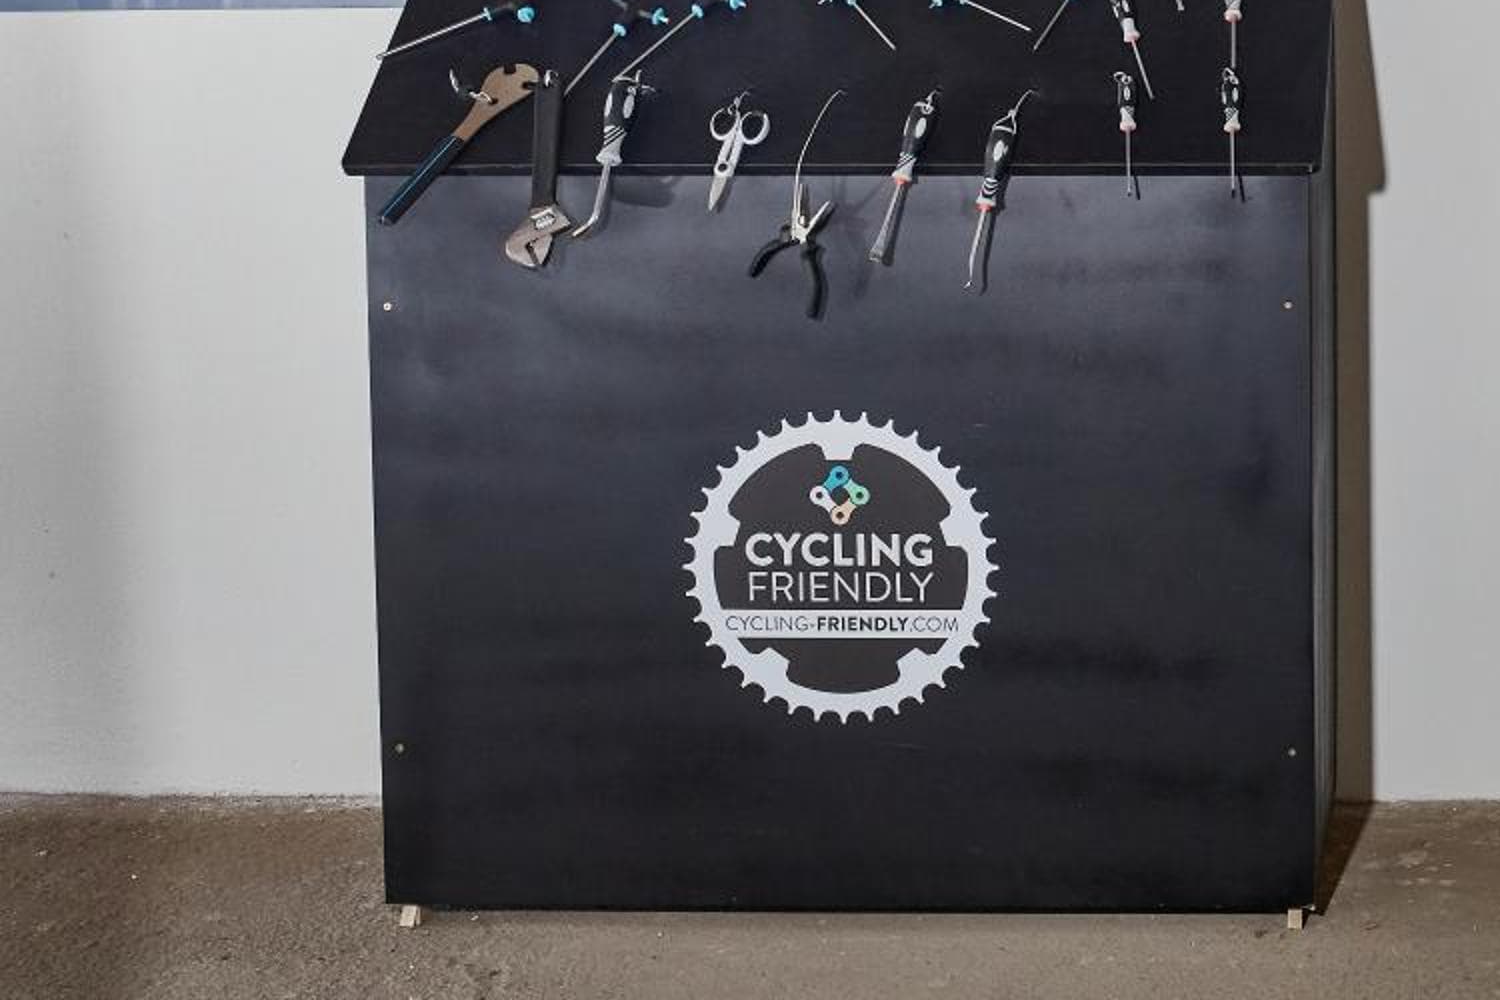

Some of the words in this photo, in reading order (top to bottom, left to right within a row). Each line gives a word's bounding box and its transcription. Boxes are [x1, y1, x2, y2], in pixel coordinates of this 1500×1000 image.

[744, 532, 934, 567] CYCLING
[748, 571, 935, 603] FRIENDLY
[724, 614, 960, 634] CYCLING-FRIENDLY.COM
